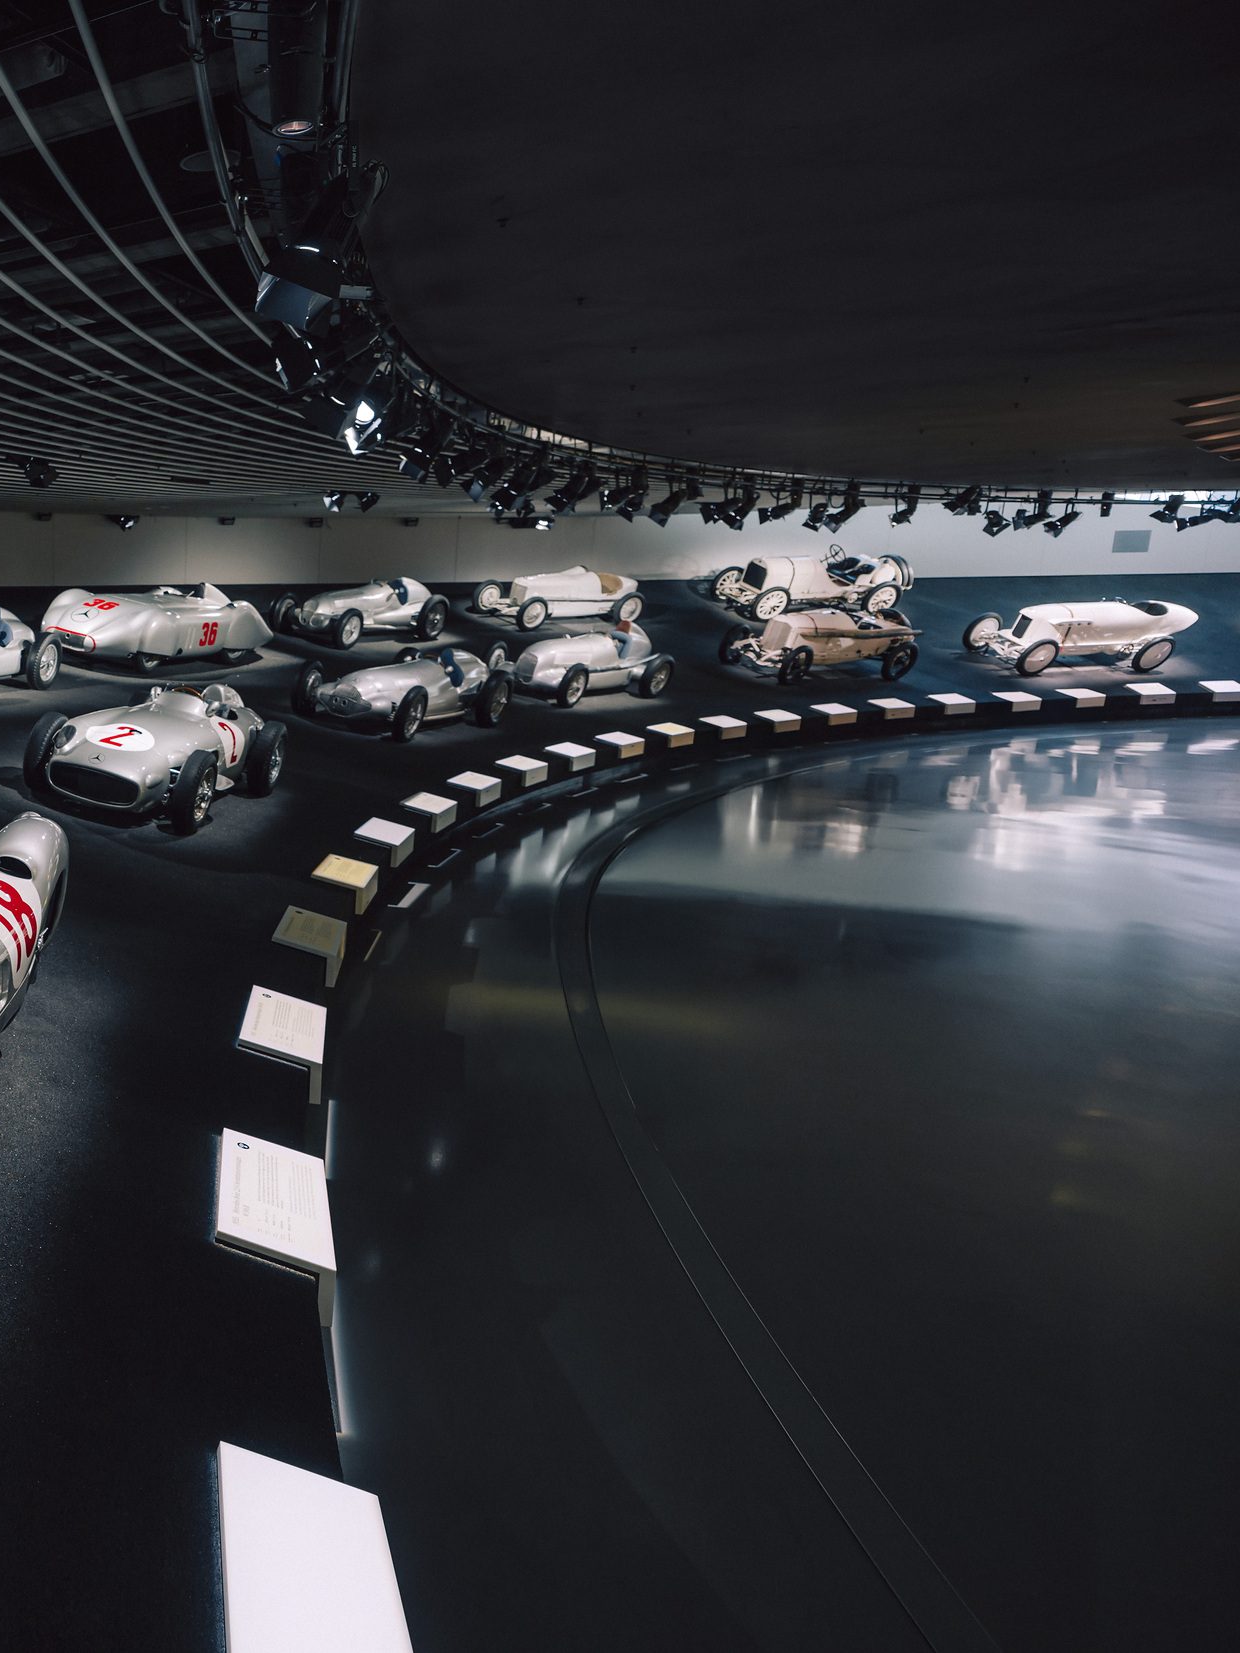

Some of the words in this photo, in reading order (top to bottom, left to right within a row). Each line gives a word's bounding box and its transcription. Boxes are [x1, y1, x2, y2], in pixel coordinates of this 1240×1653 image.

[82, 598, 120, 611] 36
[199, 621, 219, 647] 36
[99, 726, 142, 747] 2
[218, 721, 238, 764] 2
